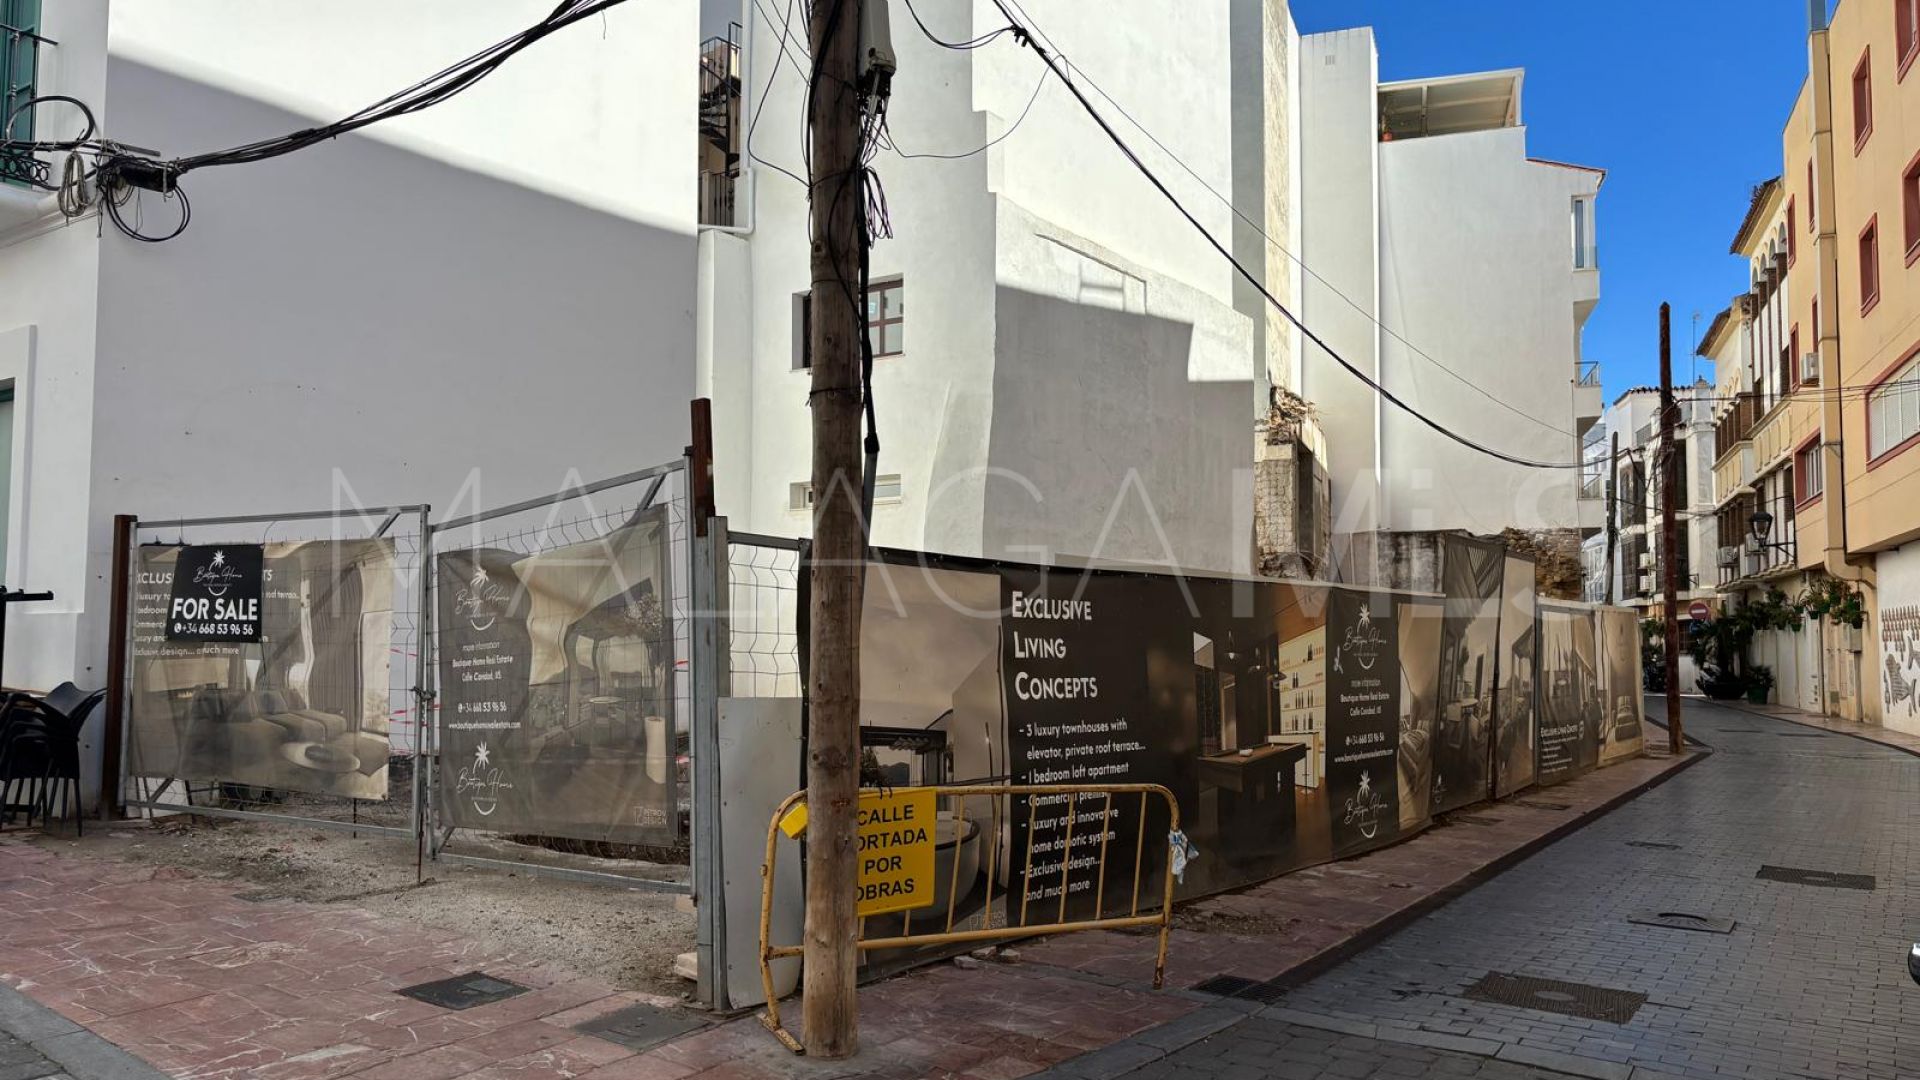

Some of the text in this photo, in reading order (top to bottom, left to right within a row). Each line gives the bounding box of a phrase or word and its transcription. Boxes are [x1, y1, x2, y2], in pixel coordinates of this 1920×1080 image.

[171, 598, 258, 621] FOR SALE
[182, 623, 254, 636] +34 668 53 96 56
[1026, 723, 1033, 738] 3
[1034, 722, 1061, 739] luxury
[1062, 719, 1109, 734] townhouses
[1110, 717, 1128, 731] with
[1026, 745, 1064, 760] elevator,
[1065, 743, 1094, 760] private
[1095, 739, 1111, 754] roof
[1033, 767, 1070, 784] bedroom
[1072, 763, 1086, 779] loft
[1087, 762, 1130, 779] apartment
[1032, 817, 1058, 832] uxury
[864, 856, 903, 876] POR
[1068, 880, 1091, 893] more
